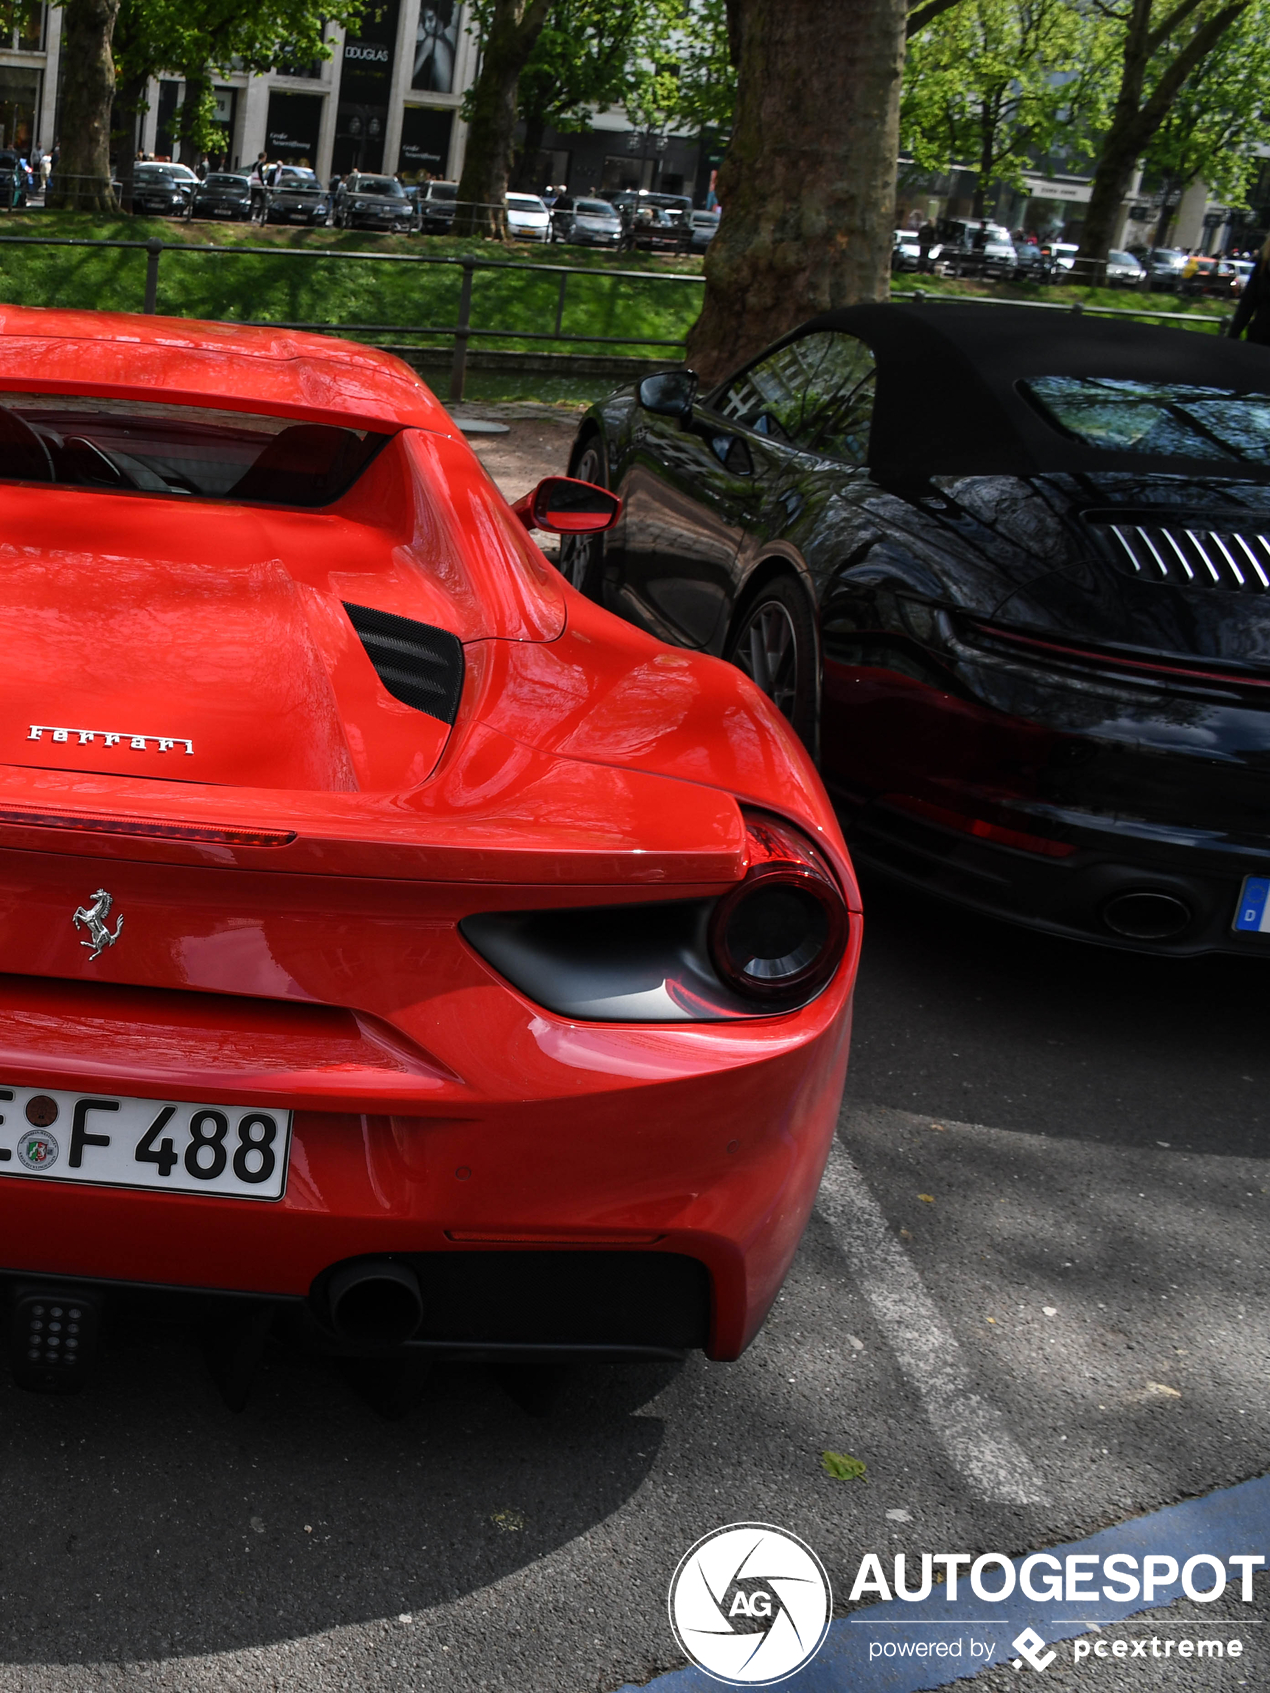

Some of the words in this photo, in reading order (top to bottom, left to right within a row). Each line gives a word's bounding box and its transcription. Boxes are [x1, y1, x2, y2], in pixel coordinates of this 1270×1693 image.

[345, 46, 389, 62] DOUGLAS
[26, 725, 195, 755] Ferrari
[1244, 909, 1256, 922] D
[68, 1098, 120, 1168] F
[134, 1105, 277, 1184] 488
